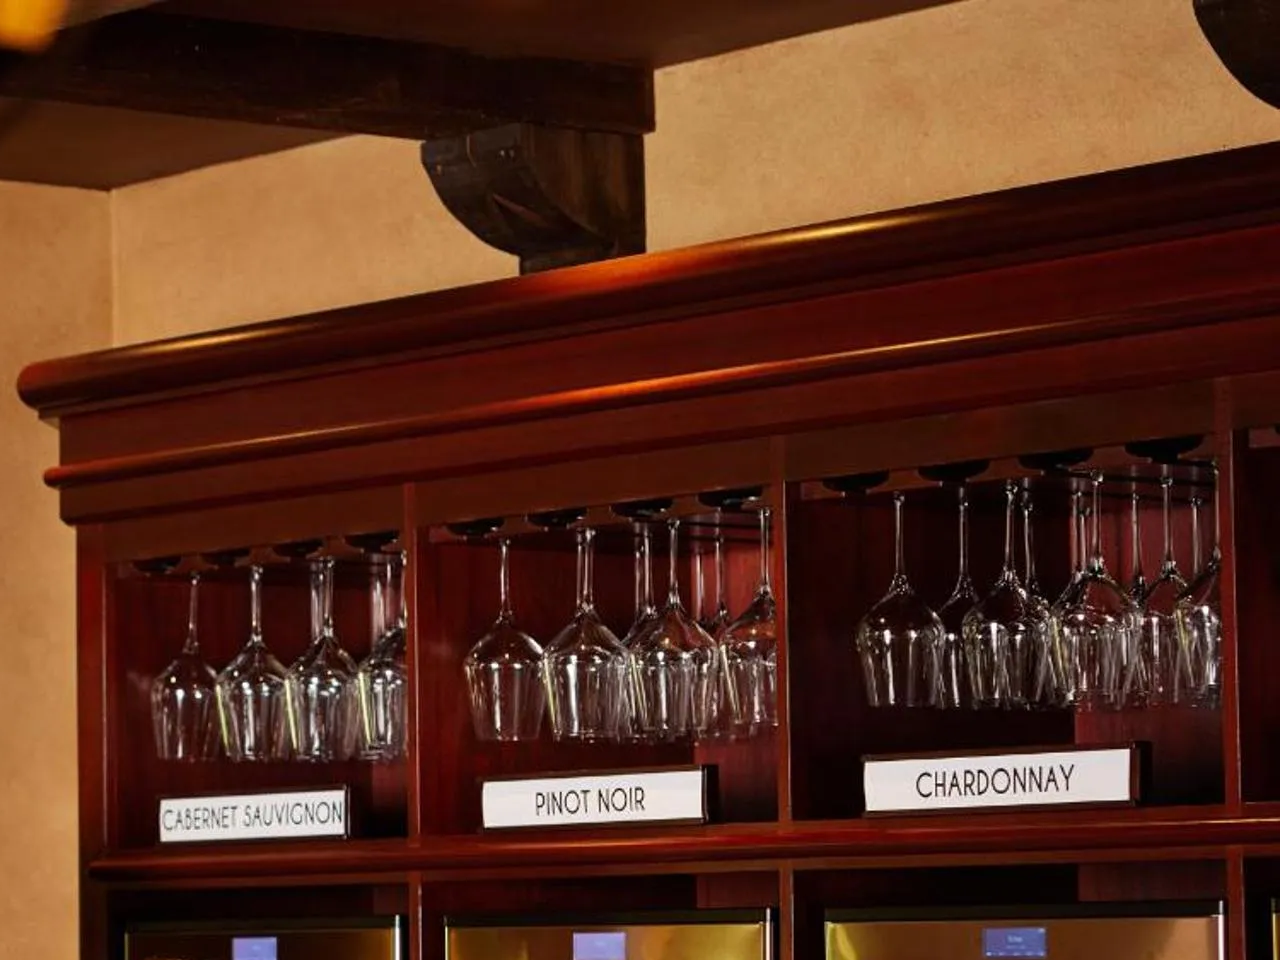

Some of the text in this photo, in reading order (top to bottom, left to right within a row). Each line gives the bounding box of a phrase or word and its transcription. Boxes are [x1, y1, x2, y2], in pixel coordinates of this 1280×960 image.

[916, 763, 1075, 798] CHARDONNAY
[163, 801, 342, 831] CABERNET SAUVIGNON
[535, 786, 645, 816] PINOT NOIR
